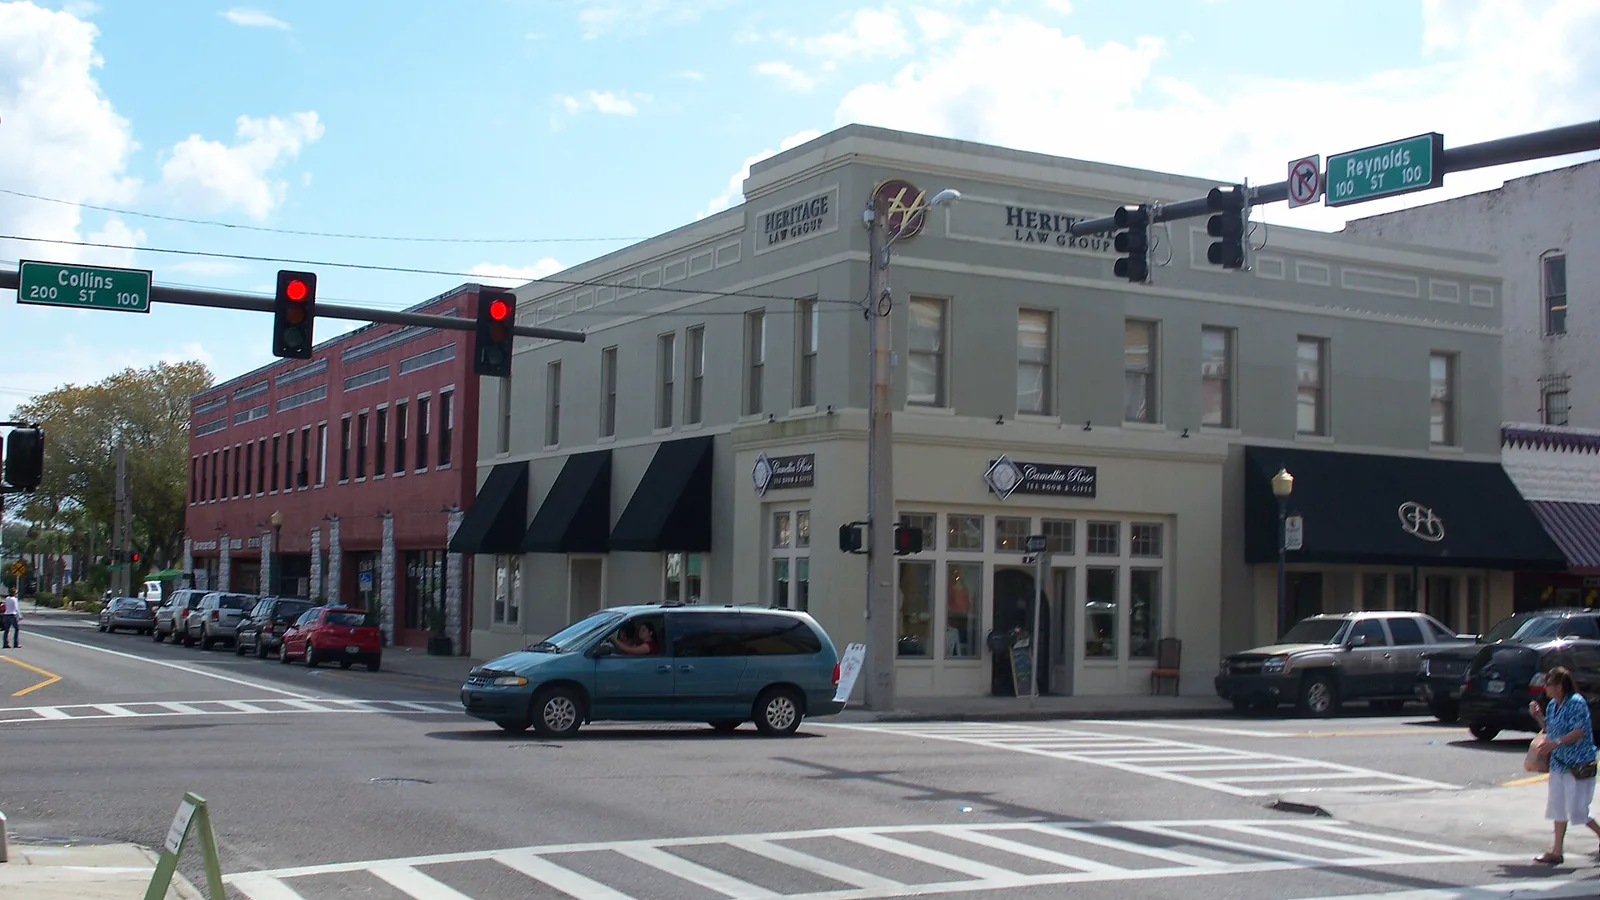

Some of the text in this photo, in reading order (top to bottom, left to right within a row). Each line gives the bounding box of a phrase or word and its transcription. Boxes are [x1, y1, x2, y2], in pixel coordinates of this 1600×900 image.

[1346, 147, 1411, 179] Reynolds
[1336, 165, 1422, 198] 100 ST 100
[764, 195, 830, 235] HERITAGE
[1005, 206, 1117, 240] HERIT
[768, 218, 824, 246] LAW GROUP
[1015, 229, 1111, 253] LAW GROUP
[58, 269, 114, 290] Collins
[30, 286, 140, 306] 200 ST 100
[1023, 464, 1094, 484] Camellia Rose
